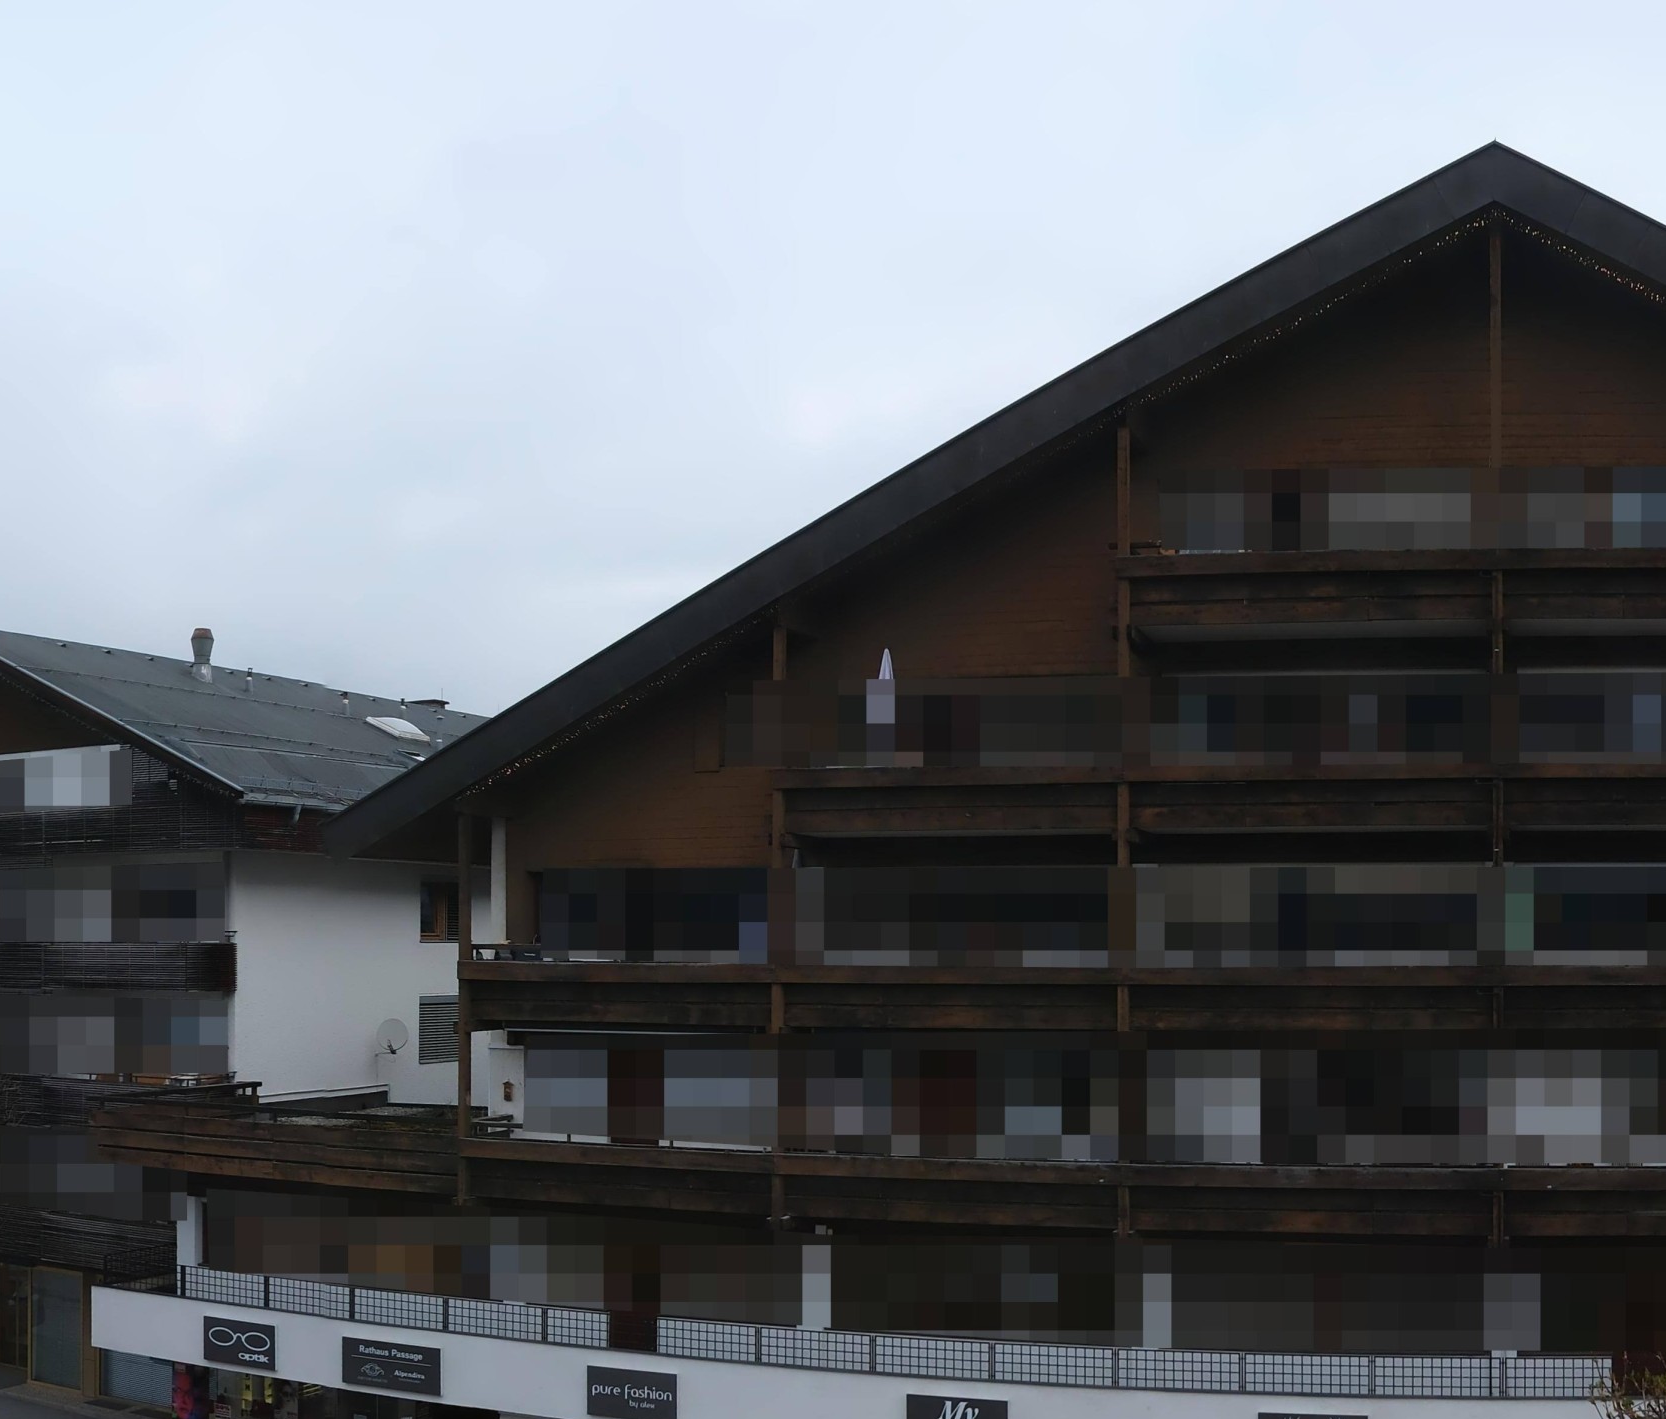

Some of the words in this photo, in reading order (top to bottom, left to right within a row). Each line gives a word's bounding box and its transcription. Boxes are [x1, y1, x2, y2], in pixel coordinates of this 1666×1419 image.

[238, 1352, 270, 1364] optik
[359, 1344, 389, 1357] Rathaus
[391, 1348, 423, 1362] Passage
[592, 1384, 622, 1399] pure
[624, 1383, 674, 1403] fashion
